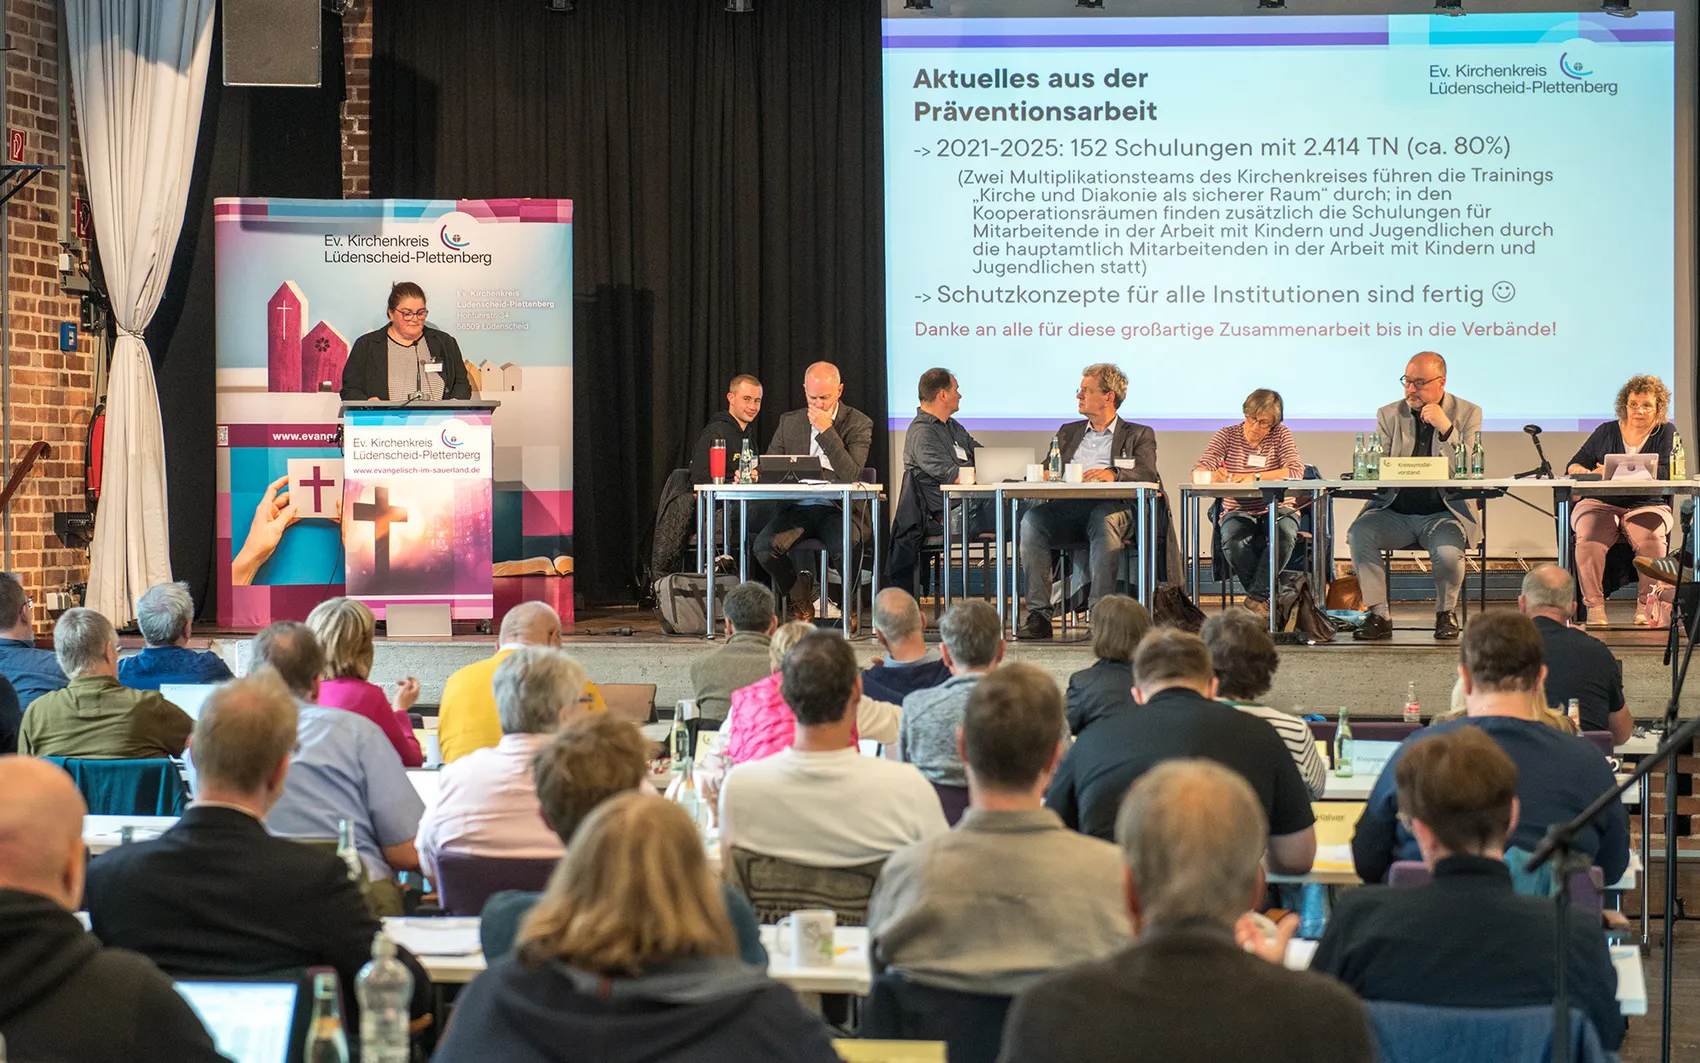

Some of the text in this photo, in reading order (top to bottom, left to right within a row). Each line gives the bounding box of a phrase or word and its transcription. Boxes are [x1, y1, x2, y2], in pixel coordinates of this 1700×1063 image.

[913, 68, 1149, 89] Aktuelles aus der
[1430, 64, 1547, 77] Ev. Kirchenkreis
[1430, 80, 1618, 96] Lüdenscheid-Plettenberg
[914, 100, 1158, 122] Präventionsarbeit
[937, 139, 1064, 157] 2021-2025:
[1071, 139, 1107, 157] 152
[1115, 138, 1252, 161] Schulungen
[1261, 138, 1297, 156] mit
[1304, 137, 1360, 156] 2.414
[1366, 137, 1399, 156] TN
[1408, 136, 1448, 160] (ca.
[1454, 136, 1512, 160] 80%)
[958, 167, 1554, 187] (Zwei Multiplikationsteams des Kirchenkreises führen die Trainings
[972, 188, 1035, 203] „Kirche
[1041, 188, 1075, 202] und
[1082, 188, 1157, 202] Diakonie
[1163, 187, 1187, 202] als
[1192, 187, 1264, 202] sicherer
[1333, 186, 1390, 203] durch;
[1396, 187, 1411, 201] in
[1417, 186, 1452, 201] den
[973, 204, 1492, 223] Kooperationsräumen finden zusätzlich die Schulungen für
[325, 234, 429, 246] Ev. Kirchenkreis
[973, 222, 1554, 241] Mitarbeitende in der Arbeit mit Kindern und Jugendlichen durch
[973, 240, 1536, 259] die hauptamtlich Mitarbeitenden in der Arbeit mit Kindern und
[325, 251, 491, 266] Lüdenscheid-Plettenberg
[972, 260, 1147, 277] Jugendlichen statt)
[938, 285, 1120, 308] Schutzkonzepte
[1127, 285, 1159, 303] für
[1166, 285, 1205, 303] alle
[1214, 285, 1359, 303] Institutionen
[1368, 284, 1414, 303] sind
[1422, 284, 1484, 308] fertig
[457, 301, 555, 309] Lüdenscheid-Plettenberg
[482, 322, 529, 330] Lüdenscheid
[915, 321, 1556, 340] Danke an alle für diese großartige Zusammenarbeit bis in die Verbände!
[353, 438, 433, 447] Ev. Kirchenkreis
[353, 450, 481, 461] Lüdenscheid-Plettenberg
